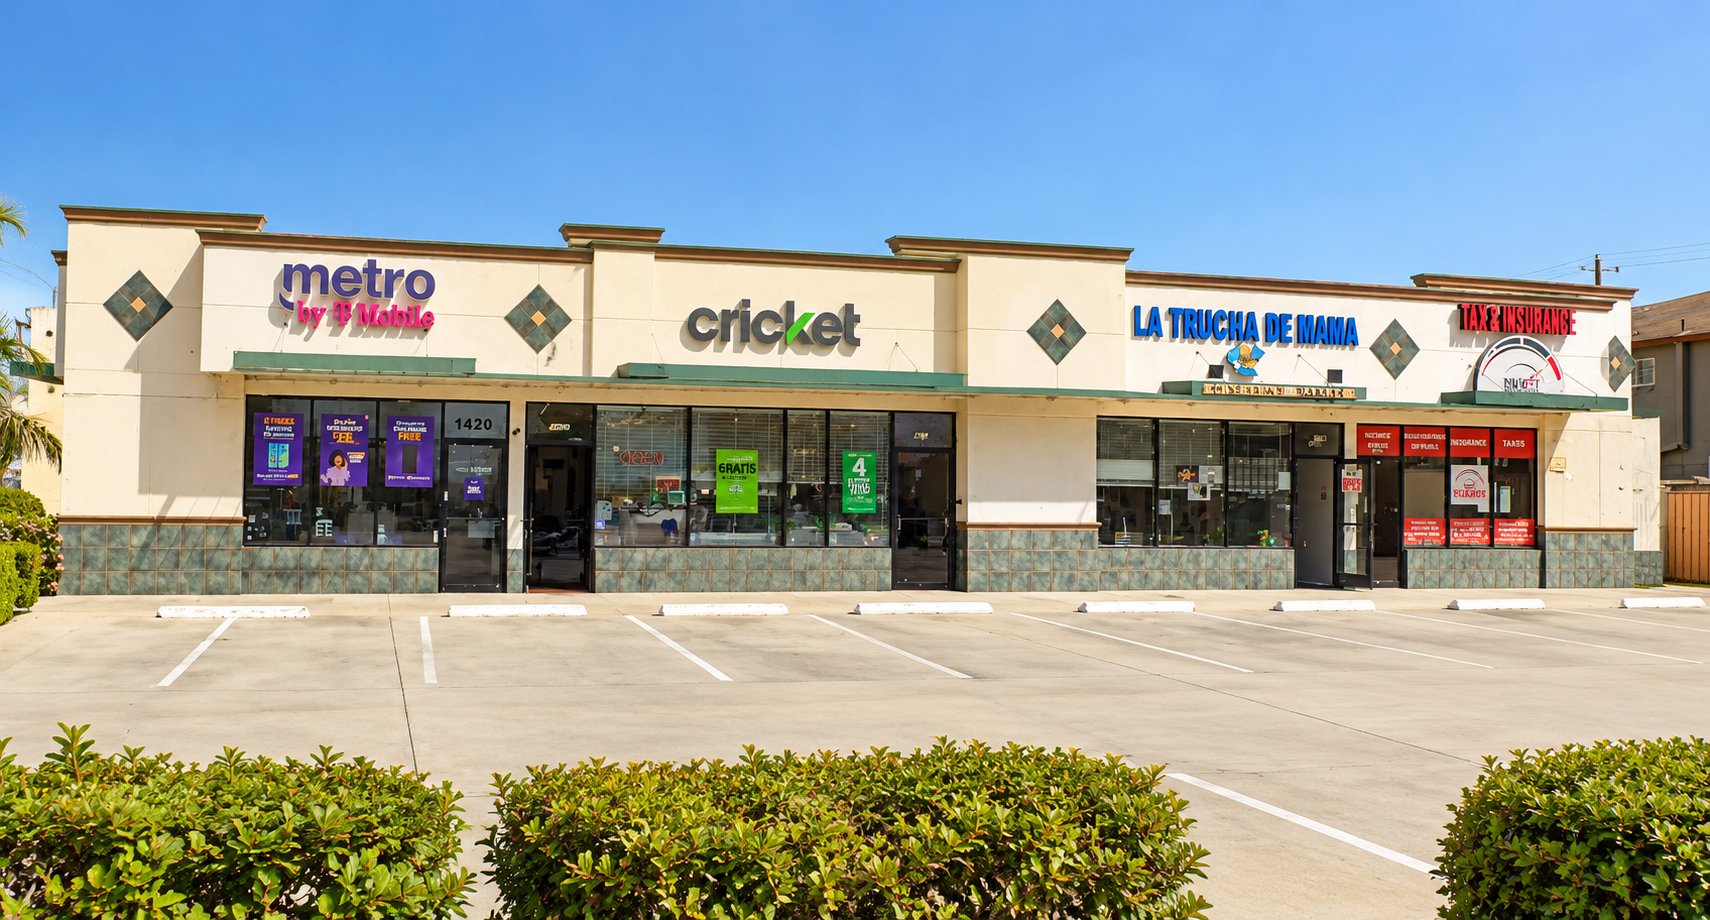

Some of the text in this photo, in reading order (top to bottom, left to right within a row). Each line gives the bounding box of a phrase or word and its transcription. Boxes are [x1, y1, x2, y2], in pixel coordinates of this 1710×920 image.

[282, 259, 436, 300] metro
[297, 300, 326, 329] by
[357, 303, 435, 329] Mobile
[687, 298, 861, 347] cricket
[1133, 305, 1359, 347] LA TRUCHA DE MAMA
[1460, 304, 1577, 336] TAX & INSURANCE
[455, 418, 493, 431] 1420
[852, 457, 867, 477] 4
